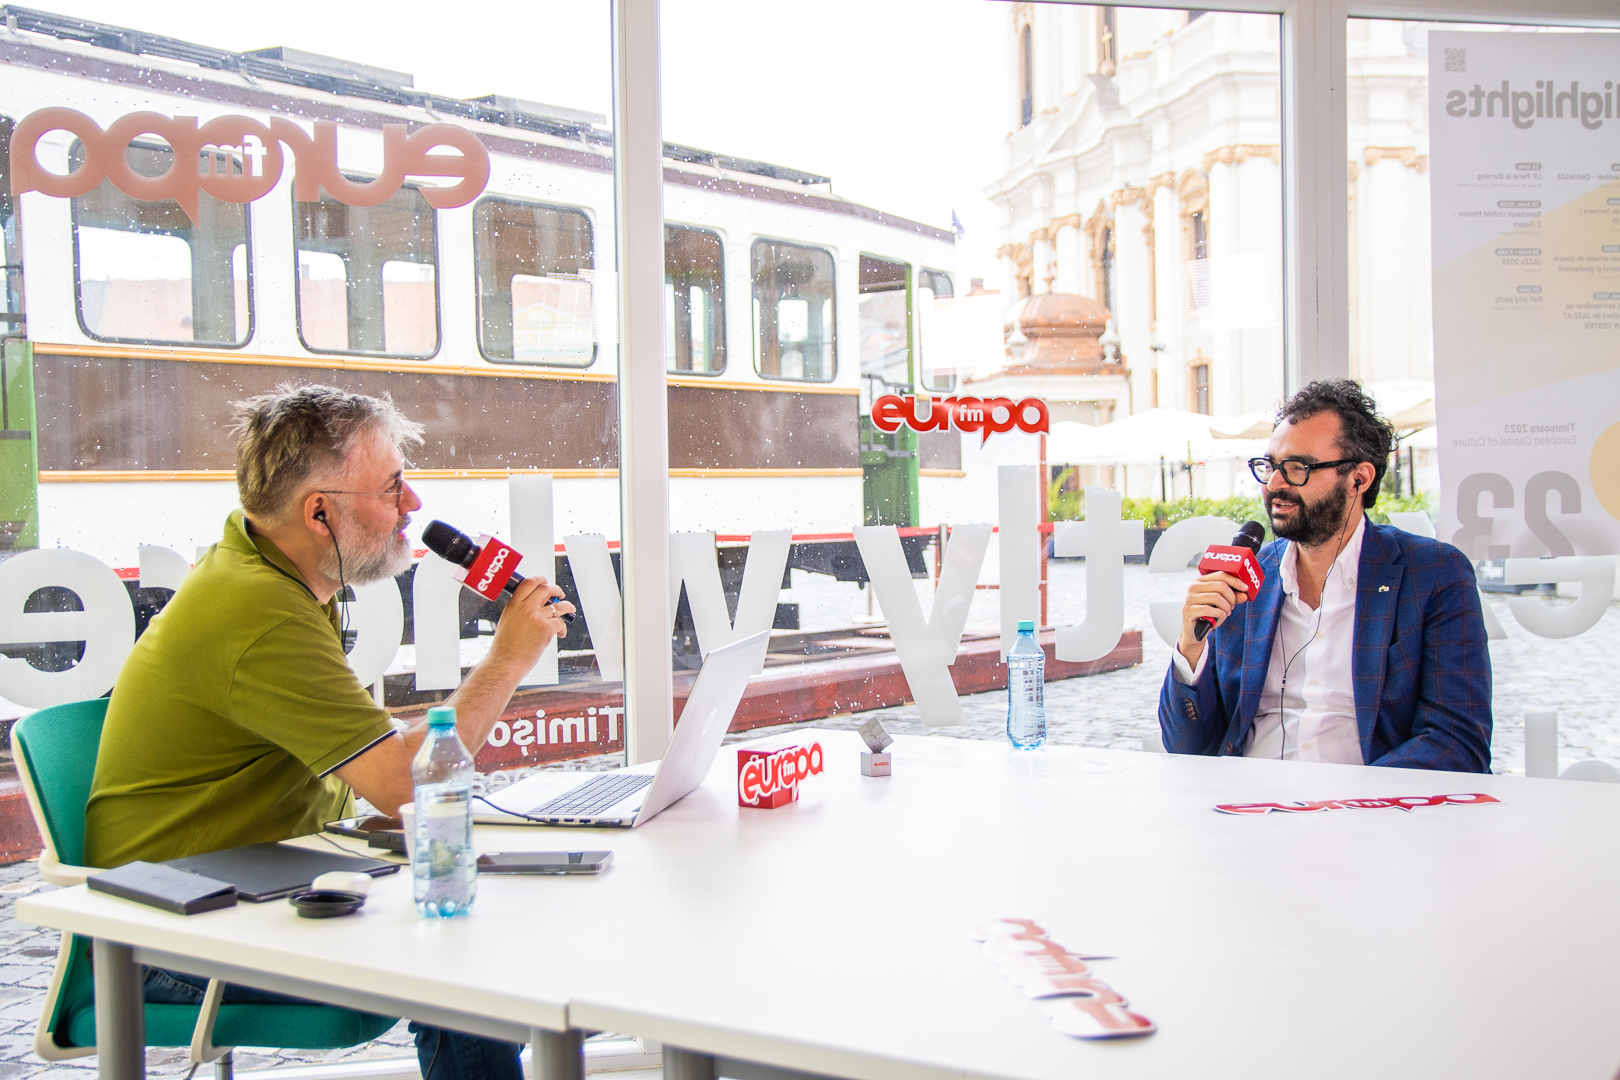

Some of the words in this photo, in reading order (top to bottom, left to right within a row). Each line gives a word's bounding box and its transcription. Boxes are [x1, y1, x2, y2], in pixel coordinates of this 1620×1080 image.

[871, 394, 1050, 450] europa
[960, 403, 984, 422] fm
[477, 548, 510, 592] europa
[1204, 551, 1242, 563] europa
[741, 742, 825, 803] europa
